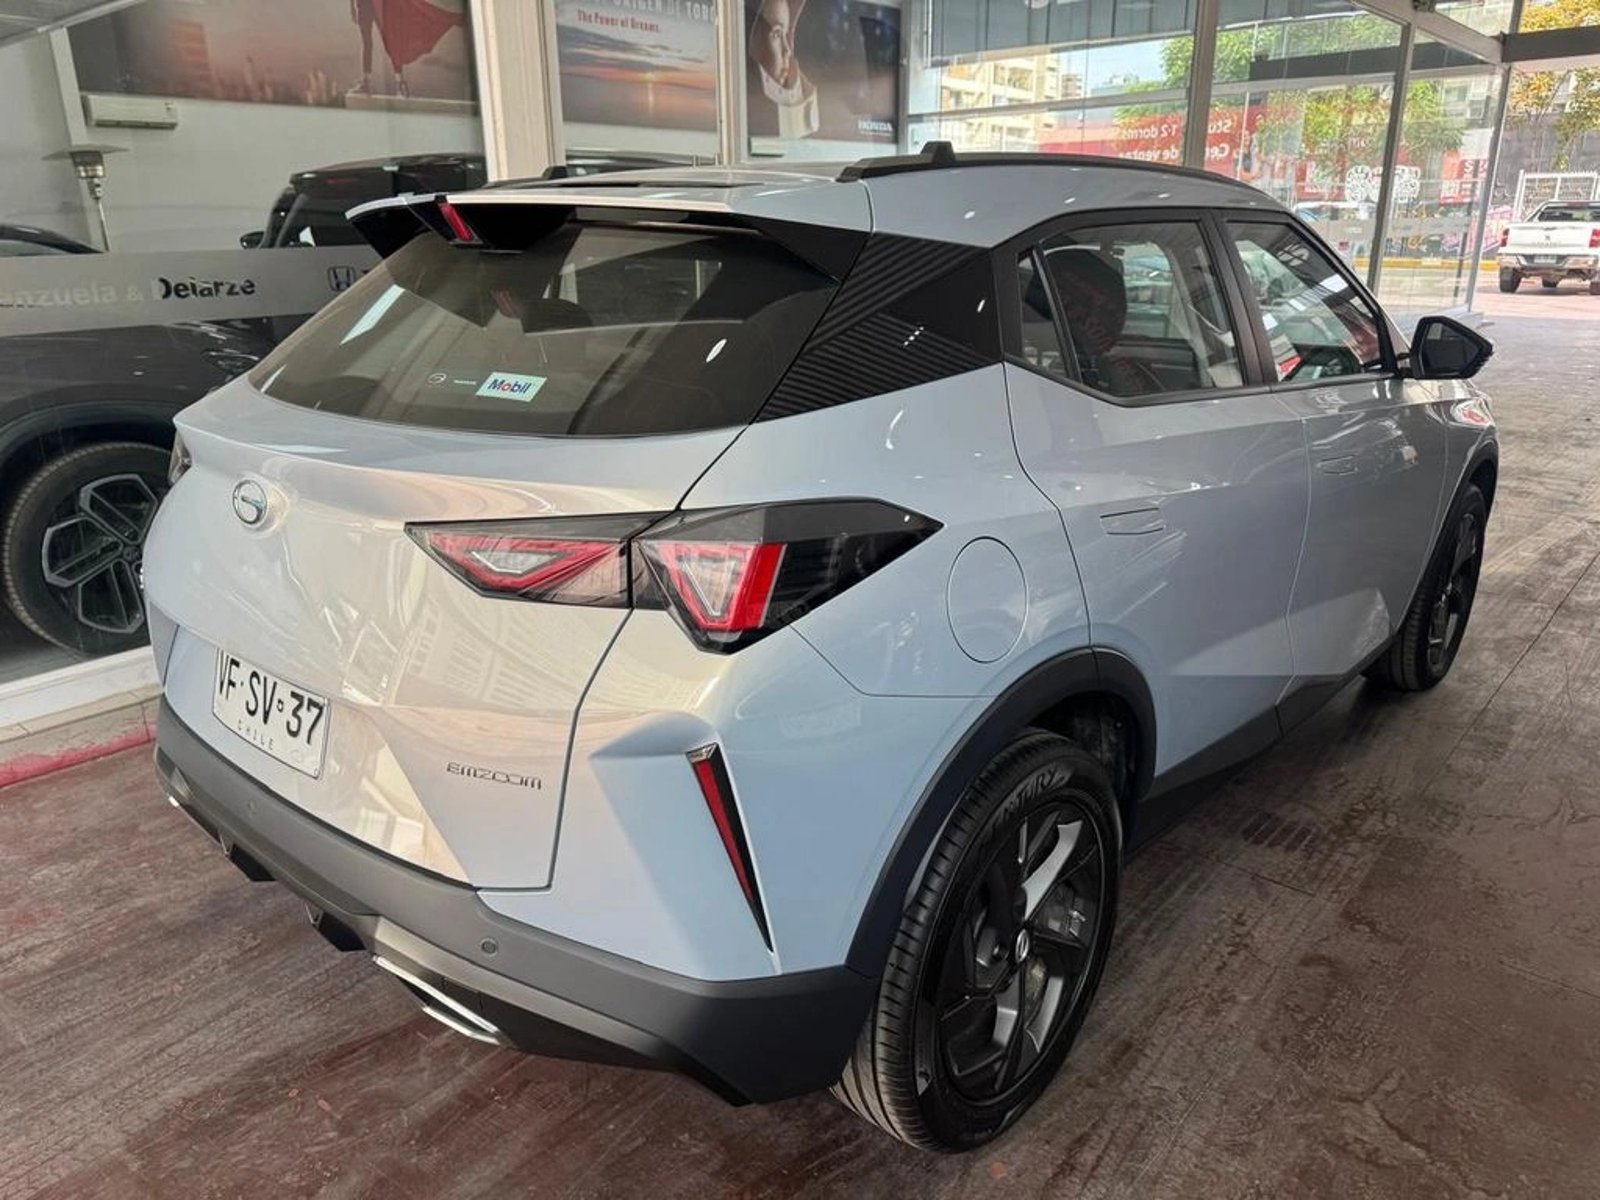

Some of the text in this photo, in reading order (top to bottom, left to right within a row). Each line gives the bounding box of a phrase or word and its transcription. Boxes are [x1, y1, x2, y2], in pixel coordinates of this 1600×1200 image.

[578, 9, 593, 23] The
[595, 11, 619, 27] Power
[127, 285, 144, 301] &
[487, 378, 532, 394] Mobil
